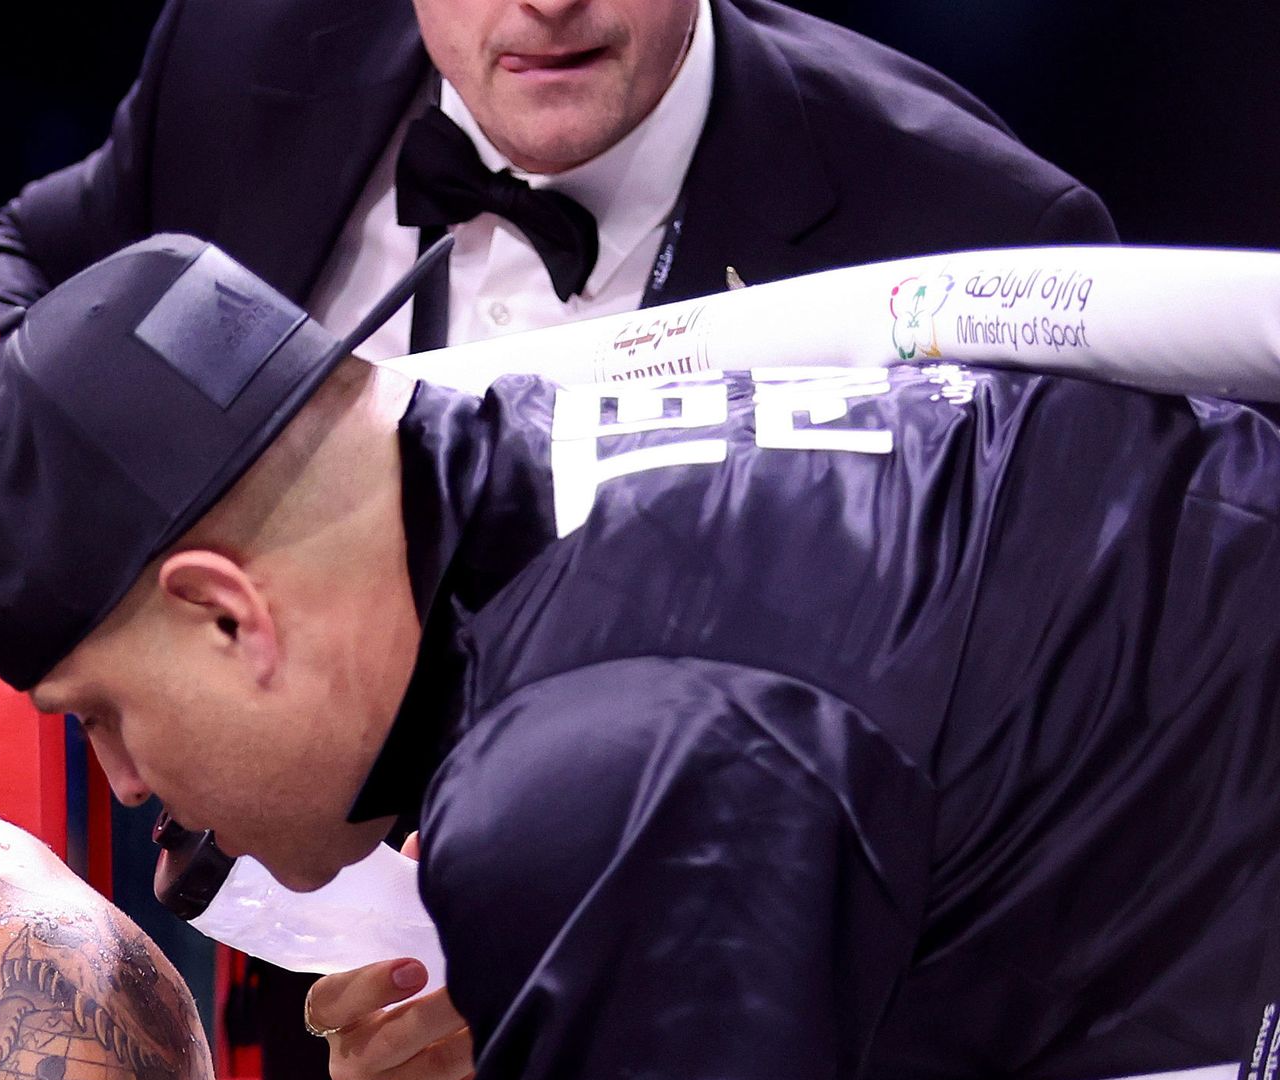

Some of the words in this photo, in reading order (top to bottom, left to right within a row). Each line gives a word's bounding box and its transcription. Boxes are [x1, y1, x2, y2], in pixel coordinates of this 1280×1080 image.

[956, 315, 1018, 351] Ministry
[1021, 316, 1040, 345] of
[1041, 316, 1090, 352] Sport
